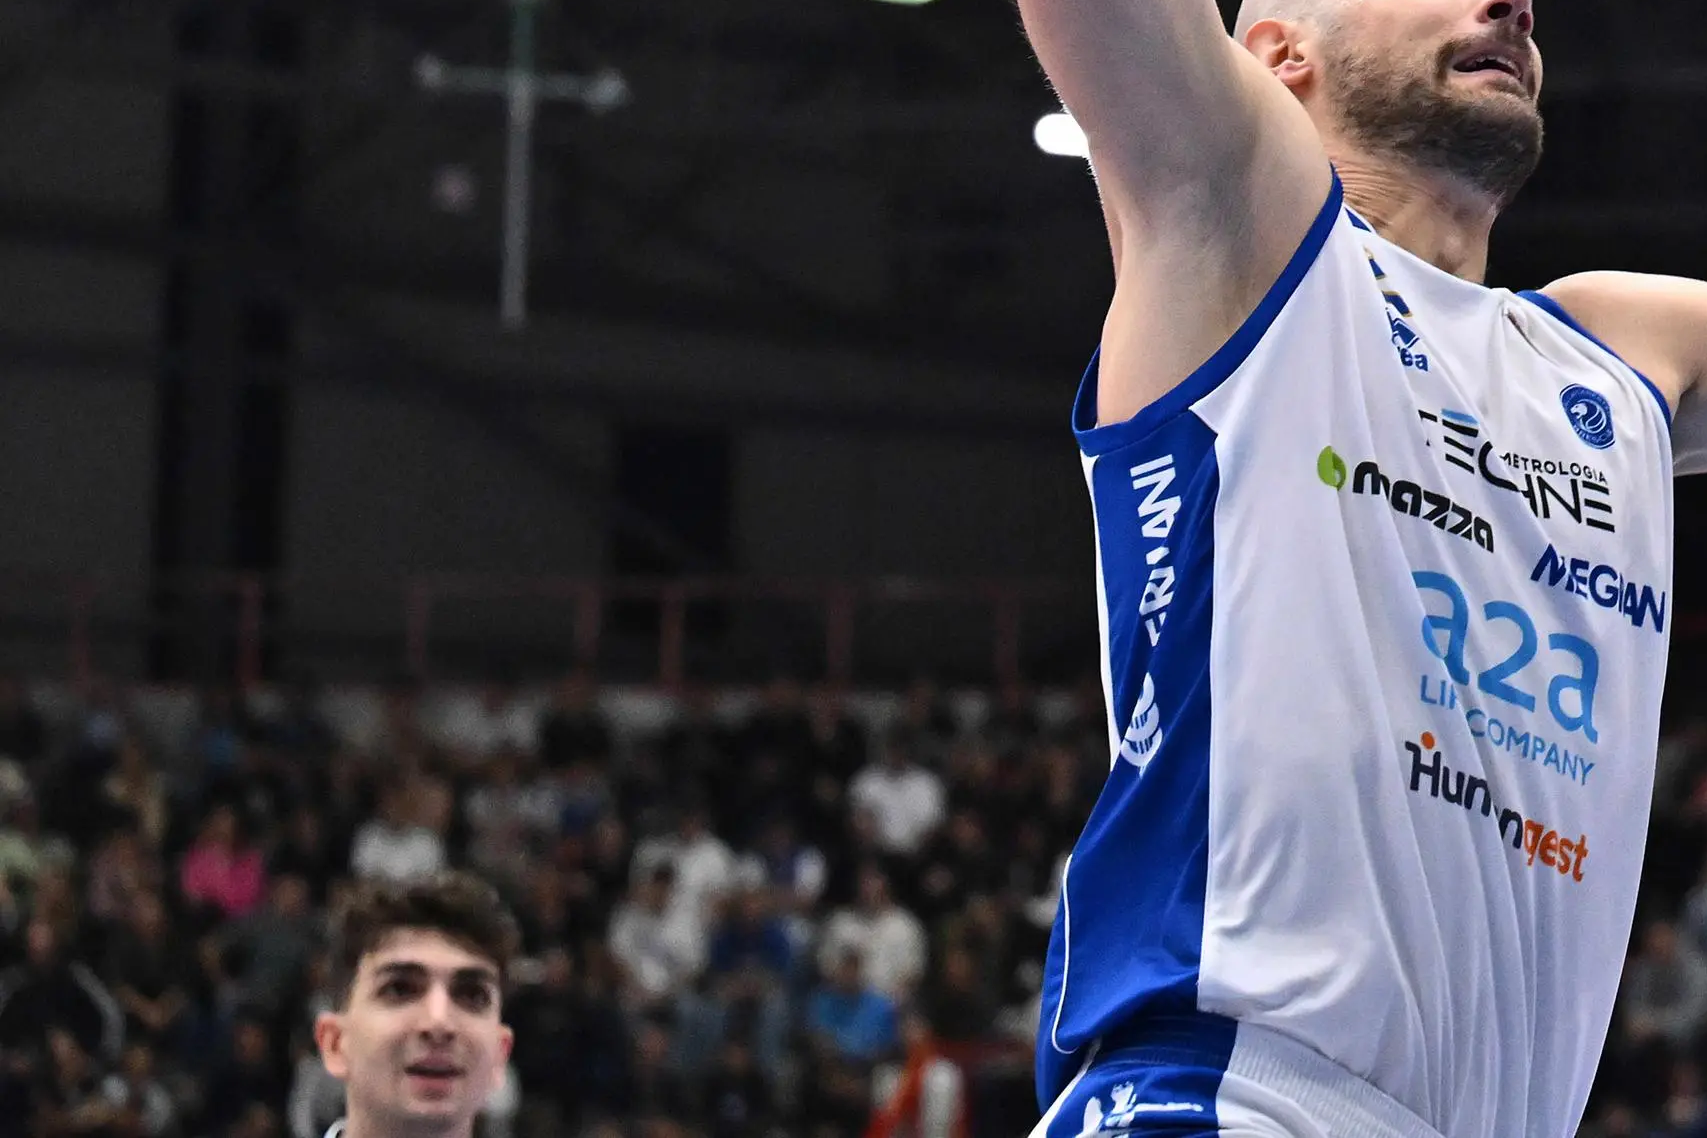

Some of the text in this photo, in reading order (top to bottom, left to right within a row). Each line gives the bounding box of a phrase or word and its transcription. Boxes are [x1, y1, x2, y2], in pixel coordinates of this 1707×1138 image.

[1352, 460, 1495, 553] mazza
[1500, 452, 1609, 485] METROLOGIA
[1411, 570, 1600, 744] a2a
[1465, 708, 1596, 787] COMPANY
